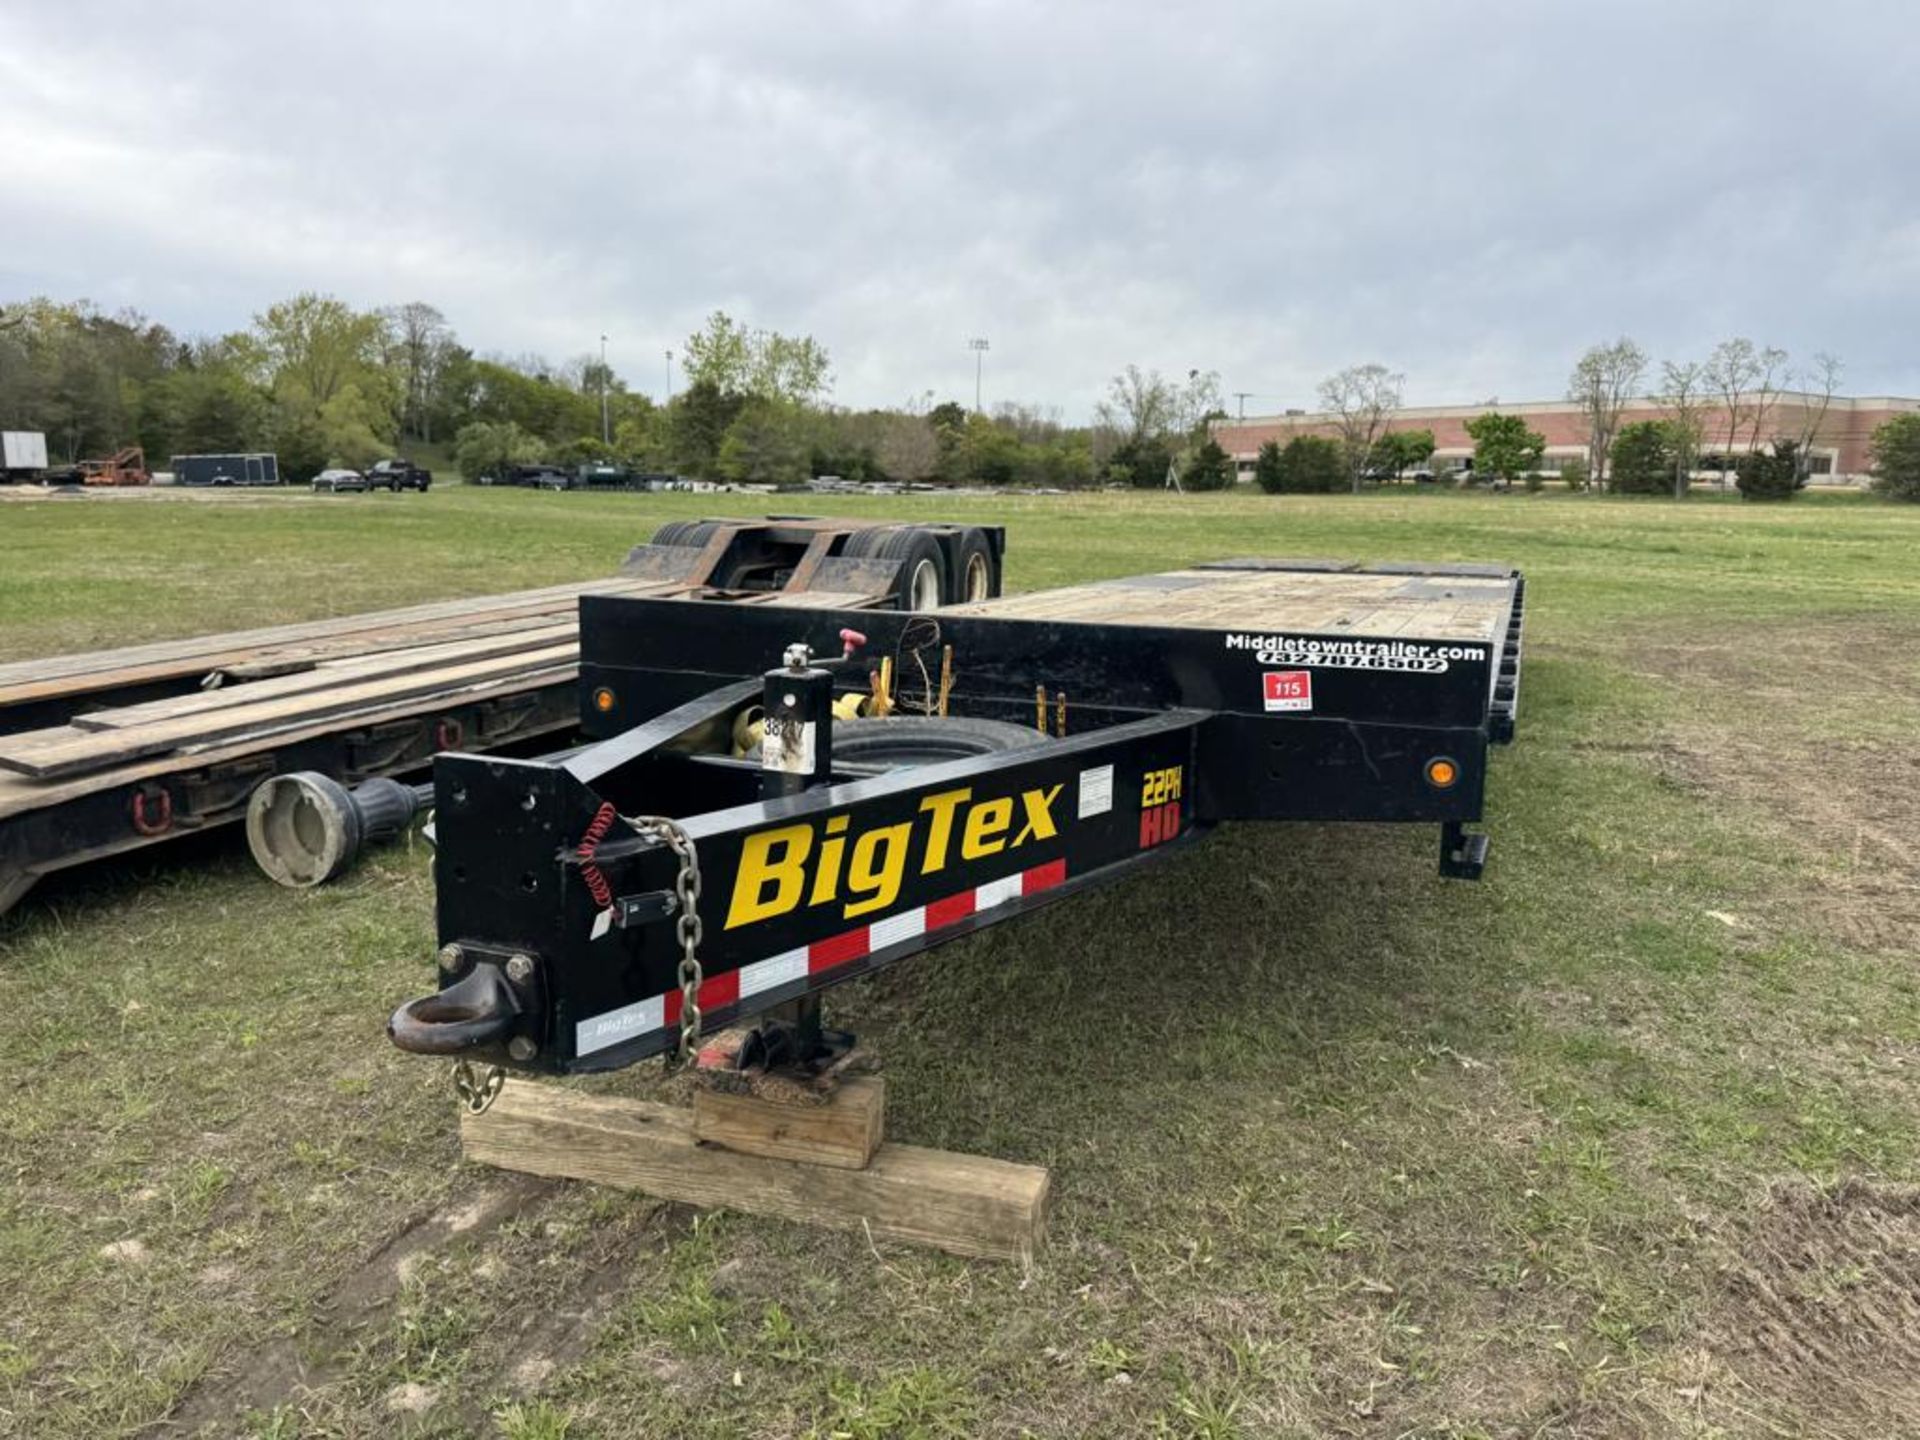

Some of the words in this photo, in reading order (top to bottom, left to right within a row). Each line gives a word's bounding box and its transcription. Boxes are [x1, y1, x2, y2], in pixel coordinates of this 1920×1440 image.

[1226, 634, 1486, 662] Middletowntrailer.com
[1261, 651, 1445, 672] 732.787.6502
[1275, 681, 1301, 697] 115
[1141, 765, 1182, 808] 22PH
[1139, 802, 1181, 849] HD
